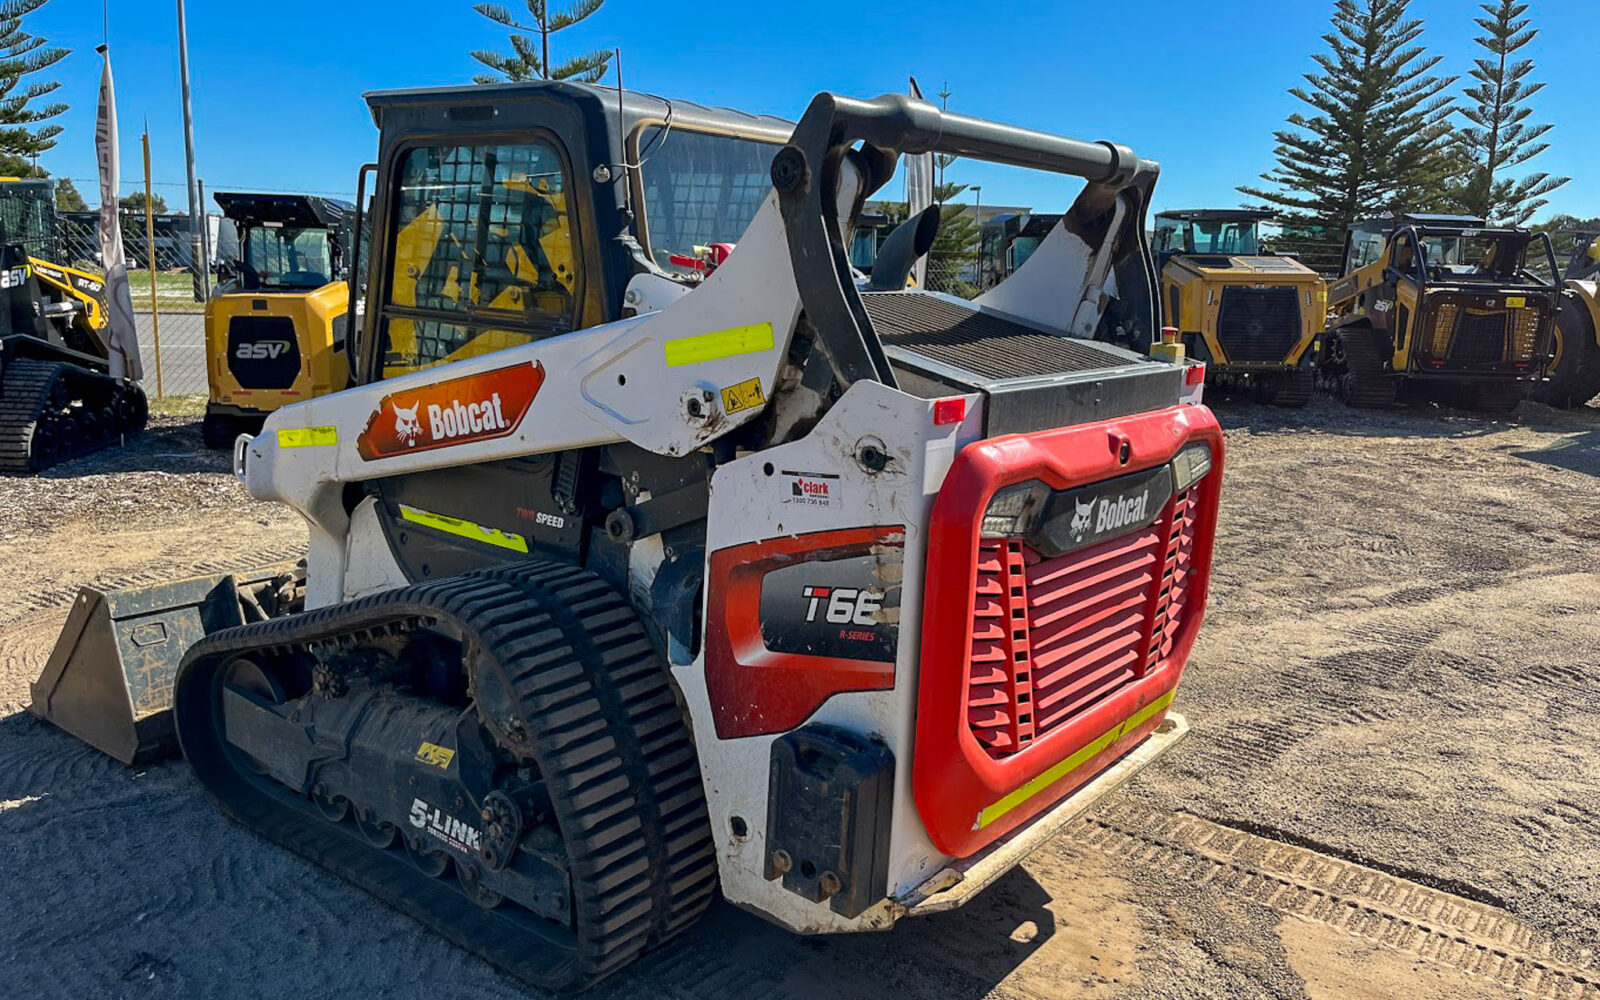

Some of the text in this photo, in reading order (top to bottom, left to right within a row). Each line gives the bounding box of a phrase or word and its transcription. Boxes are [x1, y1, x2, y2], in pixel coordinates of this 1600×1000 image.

[0, 266, 28, 288] asv
[236, 342, 286, 359] asv
[427, 393, 505, 440] Bobcat
[803, 481, 829, 494] clark
[516, 506, 564, 528] TWO SPEED
[1095, 490, 1149, 534] Bobcat
[839, 630, 876, 641] R-SERIES
[409, 798, 482, 851] 5-LINK
